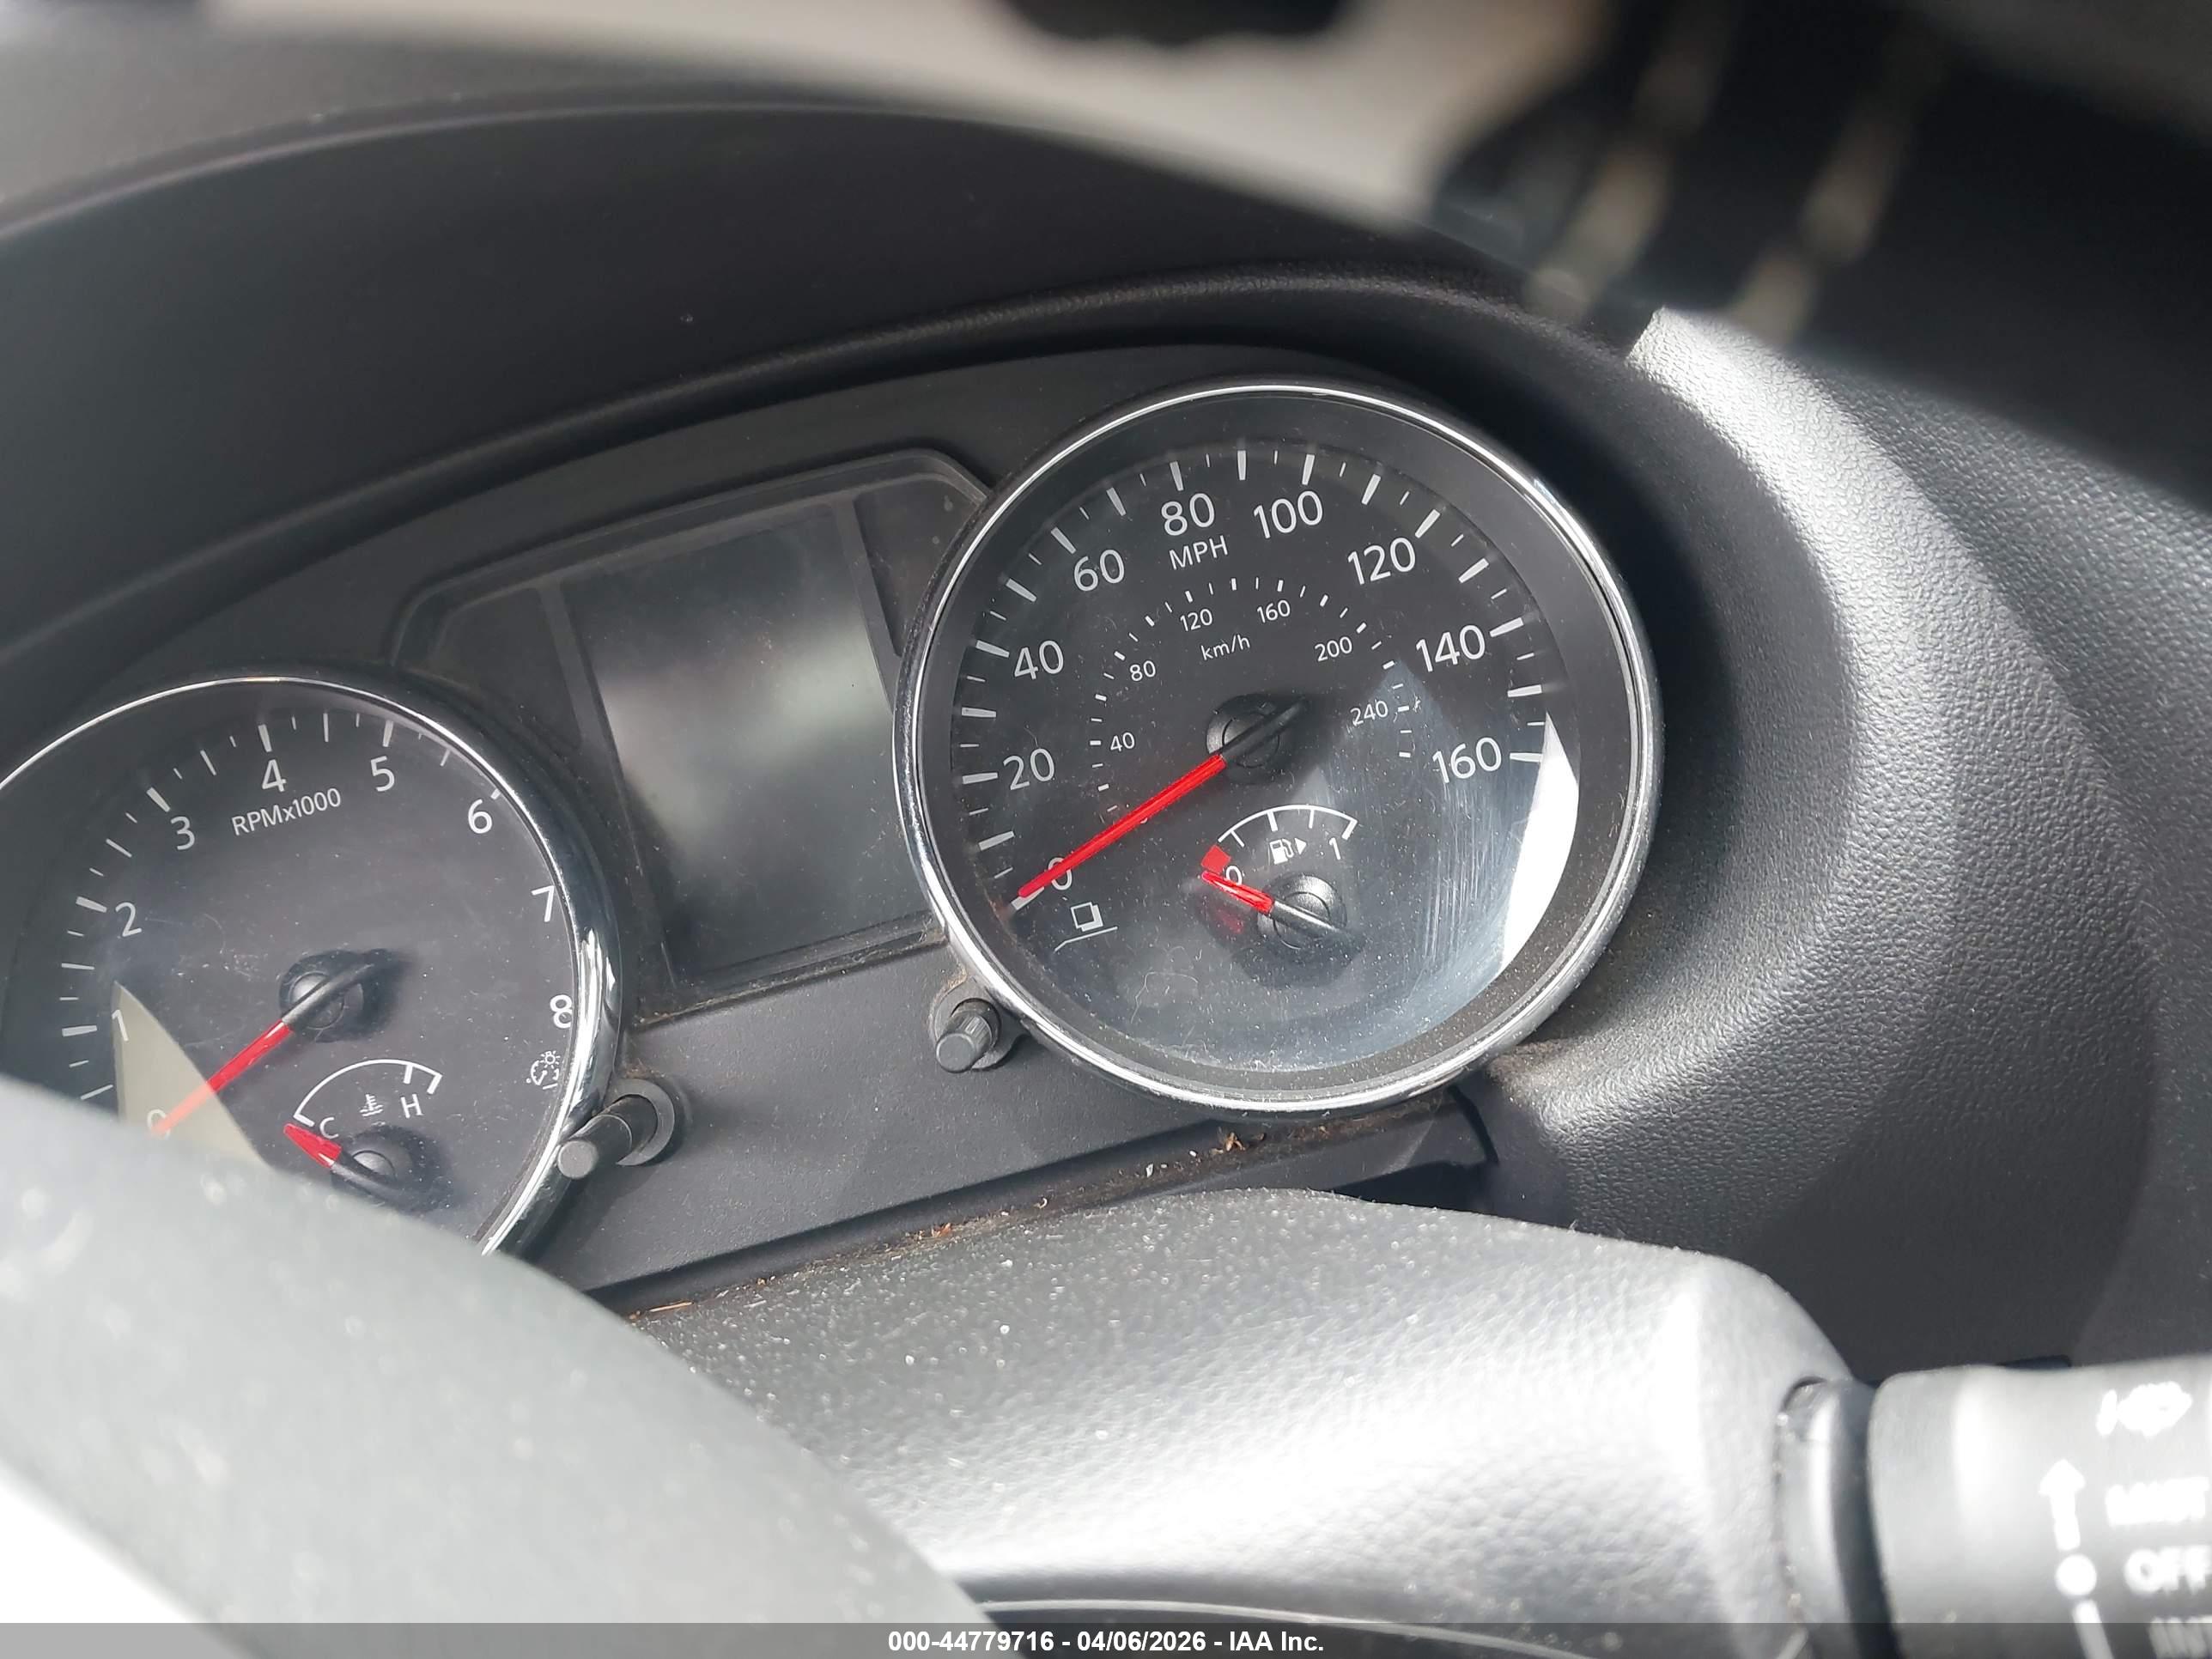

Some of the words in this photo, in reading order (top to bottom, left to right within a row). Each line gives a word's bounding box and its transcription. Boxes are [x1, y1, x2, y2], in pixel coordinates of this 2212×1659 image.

[1161, 493, 1215, 536] 80
[1253, 490, 1323, 539] 100
[1169, 535, 1229, 570] MPH
[1347, 538, 1416, 586] 120
[1073, 549, 1125, 592] 60
[1180, 608, 1212, 632] 120
[1256, 599, 1291, 623] 160
[1013, 640, 1064, 680] 40
[1200, 634, 1250, 661] km/h
[1314, 636, 1352, 662] 200
[1415, 624, 1486, 672] 140
[1129, 660, 1156, 681] 80
[1350, 700, 1389, 726] 240
[1109, 732, 1135, 752] 40
[261, 759, 287, 793] 4
[370, 756, 395, 793] 5
[1003, 748, 1054, 791] 20
[1431, 737, 1502, 784] 160
[231, 787, 342, 836] RPMx1000
[468, 799, 493, 835] 6
[171, 816, 195, 850] 3
[1328, 837, 1341, 860] 1
[1048, 857, 1073, 890] 0
[115, 902, 143, 938] 2
[531, 884, 556, 922] 7
[111, 1009, 130, 1042] 1
[550, 994, 573, 1030] 8
[400, 1093, 424, 1119] H
[319, 1116, 339, 1139] C
